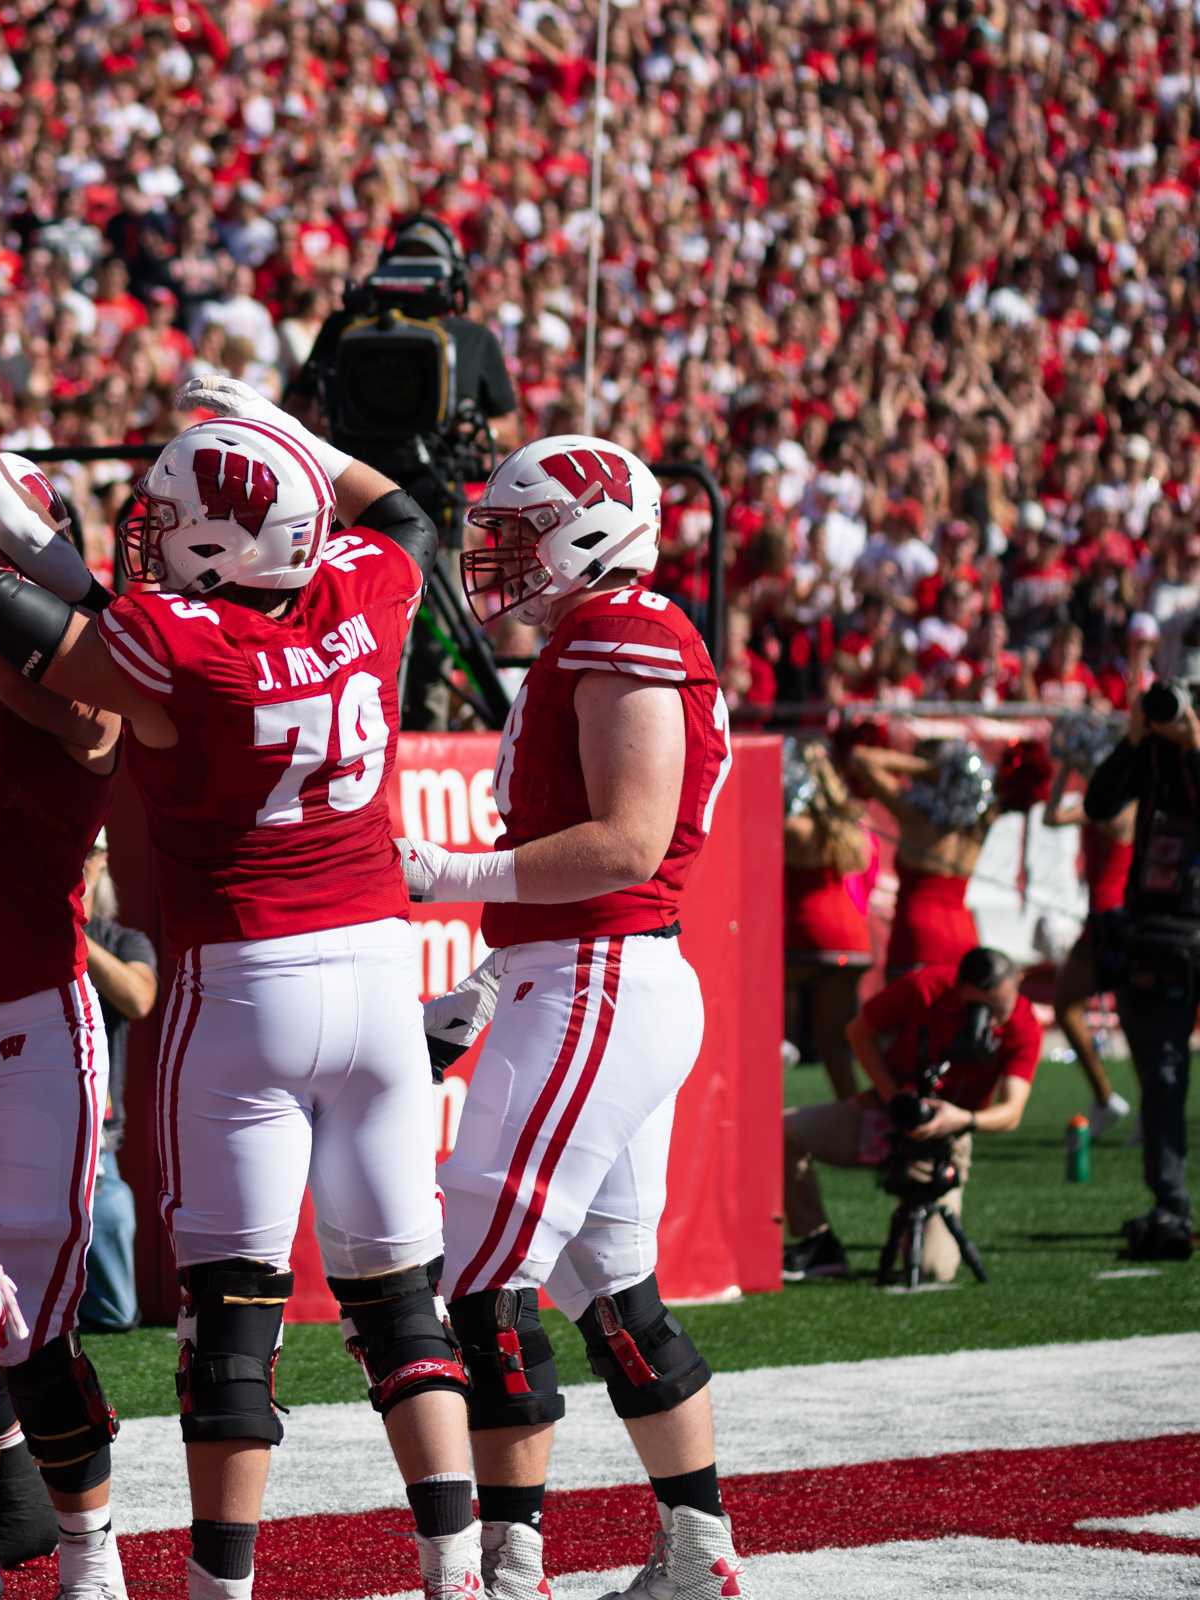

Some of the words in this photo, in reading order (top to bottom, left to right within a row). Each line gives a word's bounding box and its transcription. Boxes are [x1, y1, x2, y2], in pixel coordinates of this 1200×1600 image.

[193, 448, 280, 541] W
[538, 449, 634, 512] W
[256, 651, 281, 691] J.
[283, 613, 378, 687] NELSON
[254, 671, 390, 827] 79
